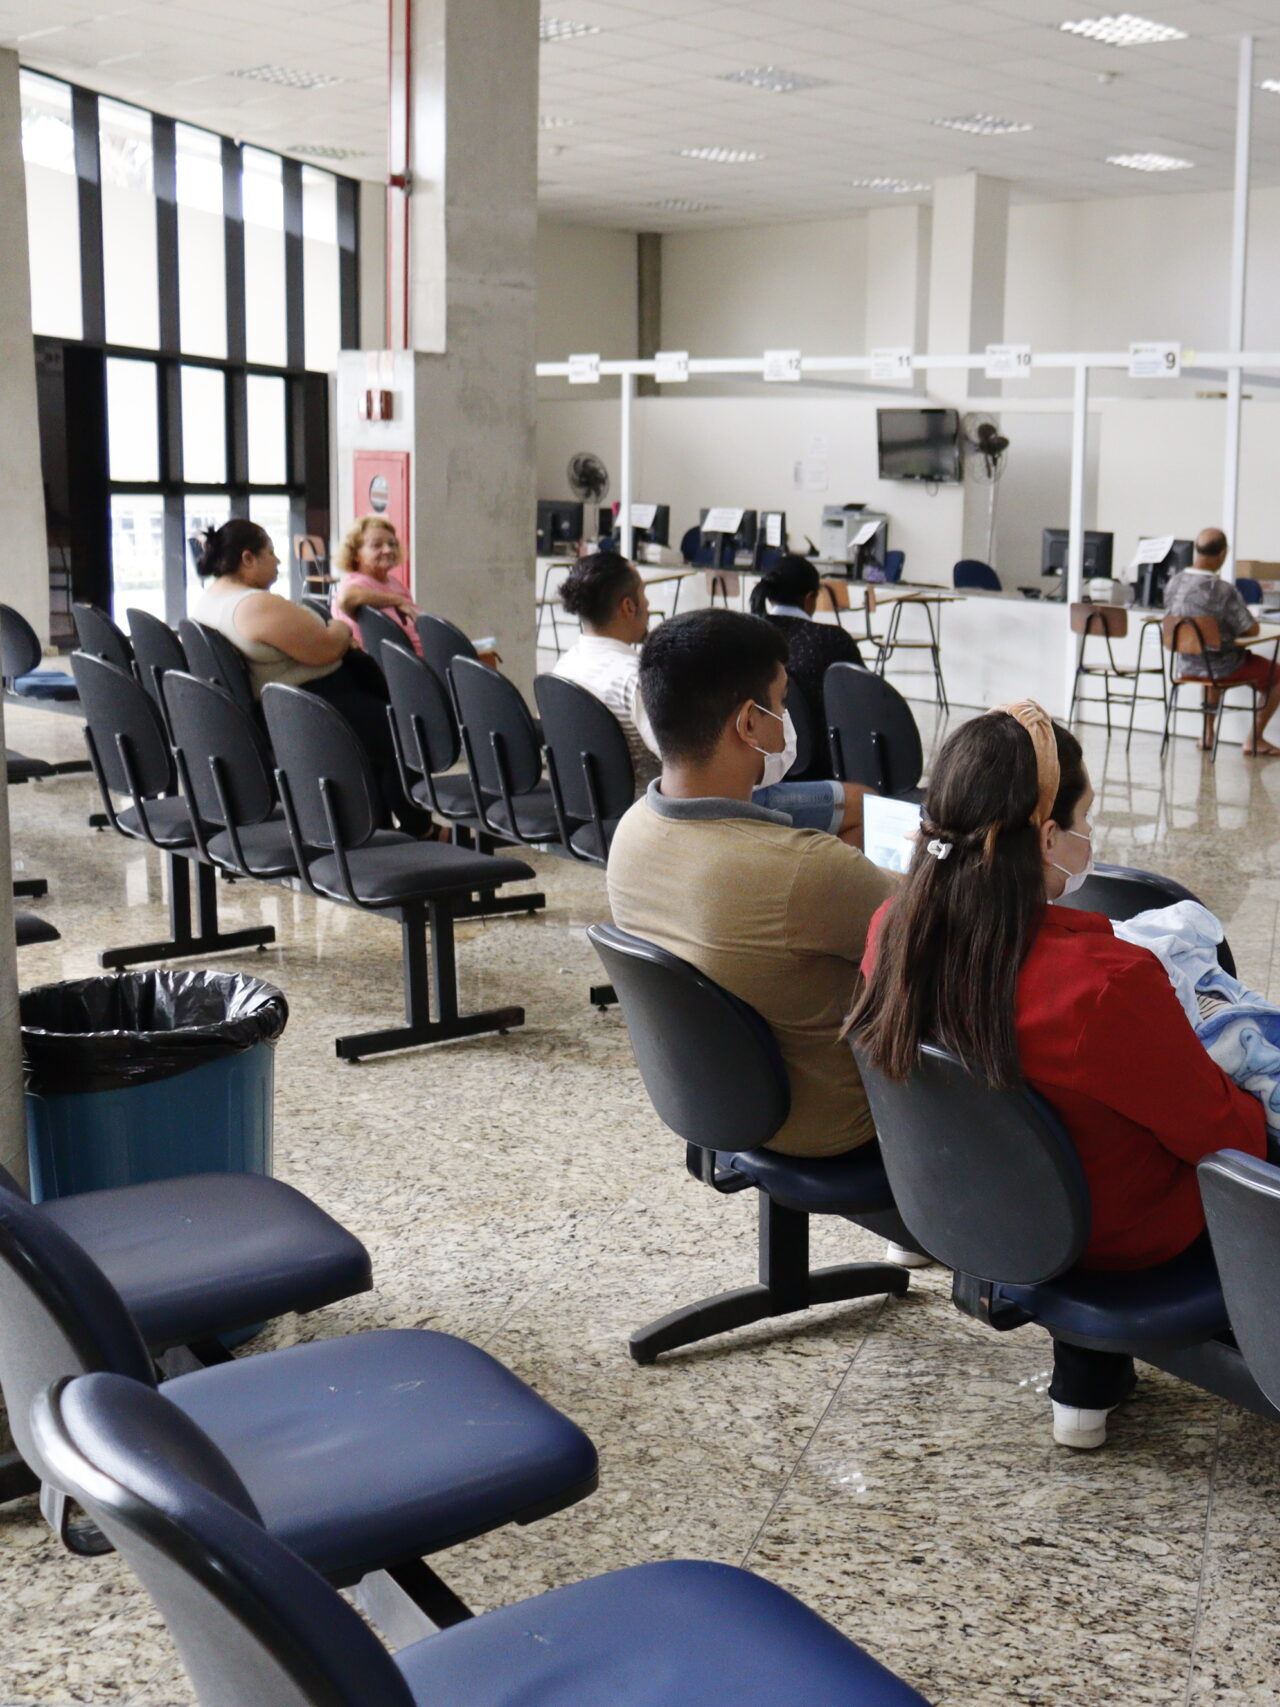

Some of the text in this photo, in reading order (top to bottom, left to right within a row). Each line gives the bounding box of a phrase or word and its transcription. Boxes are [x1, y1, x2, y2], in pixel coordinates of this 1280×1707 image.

[789, 358, 801, 370] 12
[898, 355, 911, 367] 11
[1016, 353, 1032, 366] 10
[1164, 351, 1176, 370] 9
